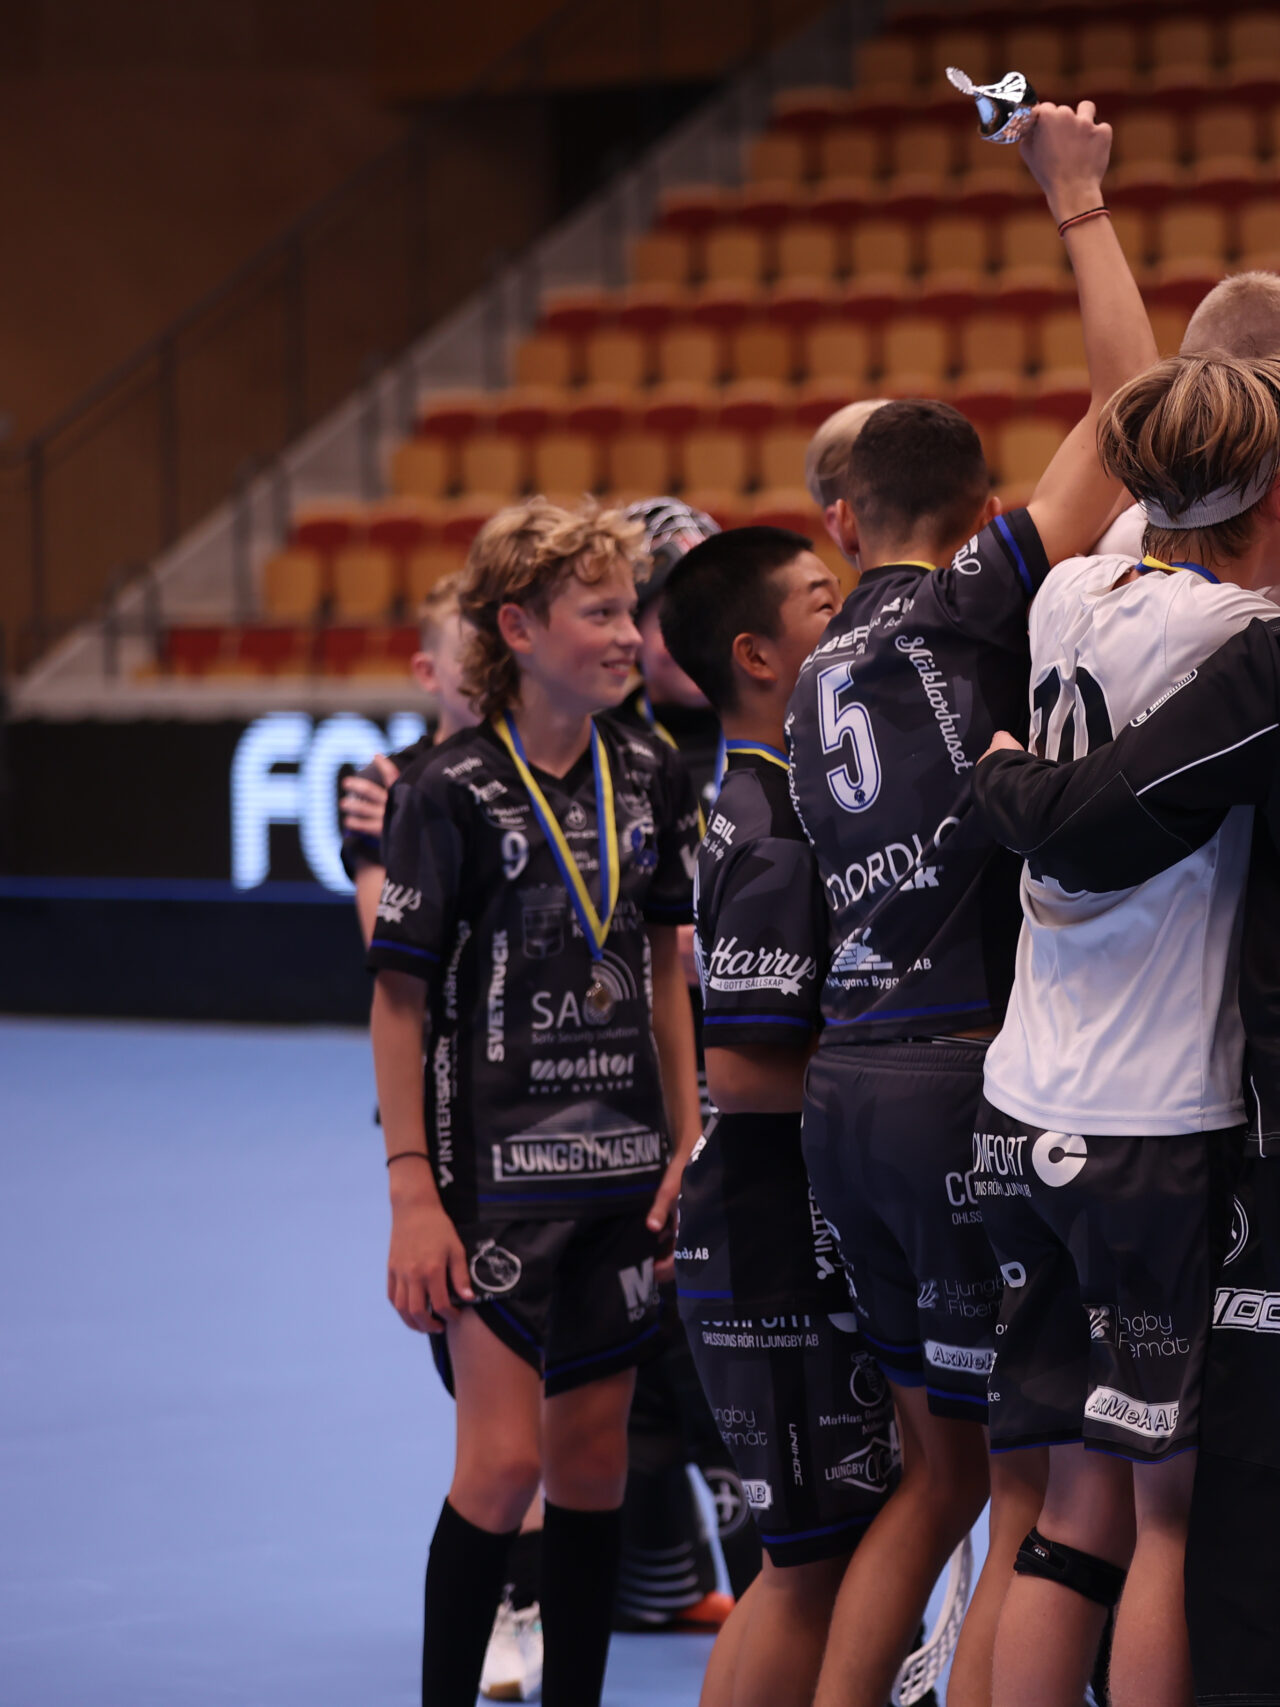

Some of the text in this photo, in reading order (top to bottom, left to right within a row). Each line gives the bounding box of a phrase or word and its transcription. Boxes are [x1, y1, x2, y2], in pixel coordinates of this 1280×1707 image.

[815, 658, 883, 814] 5
[502, 830, 531, 881] 9
[708, 935, 817, 981] Harrys
[737, 1331, 754, 1348] RÖR
[761, 1333, 802, 1348] LJUNGBY
[805, 1333, 820, 1347] AB
[788, 1423, 803, 1486] UNIHOC
